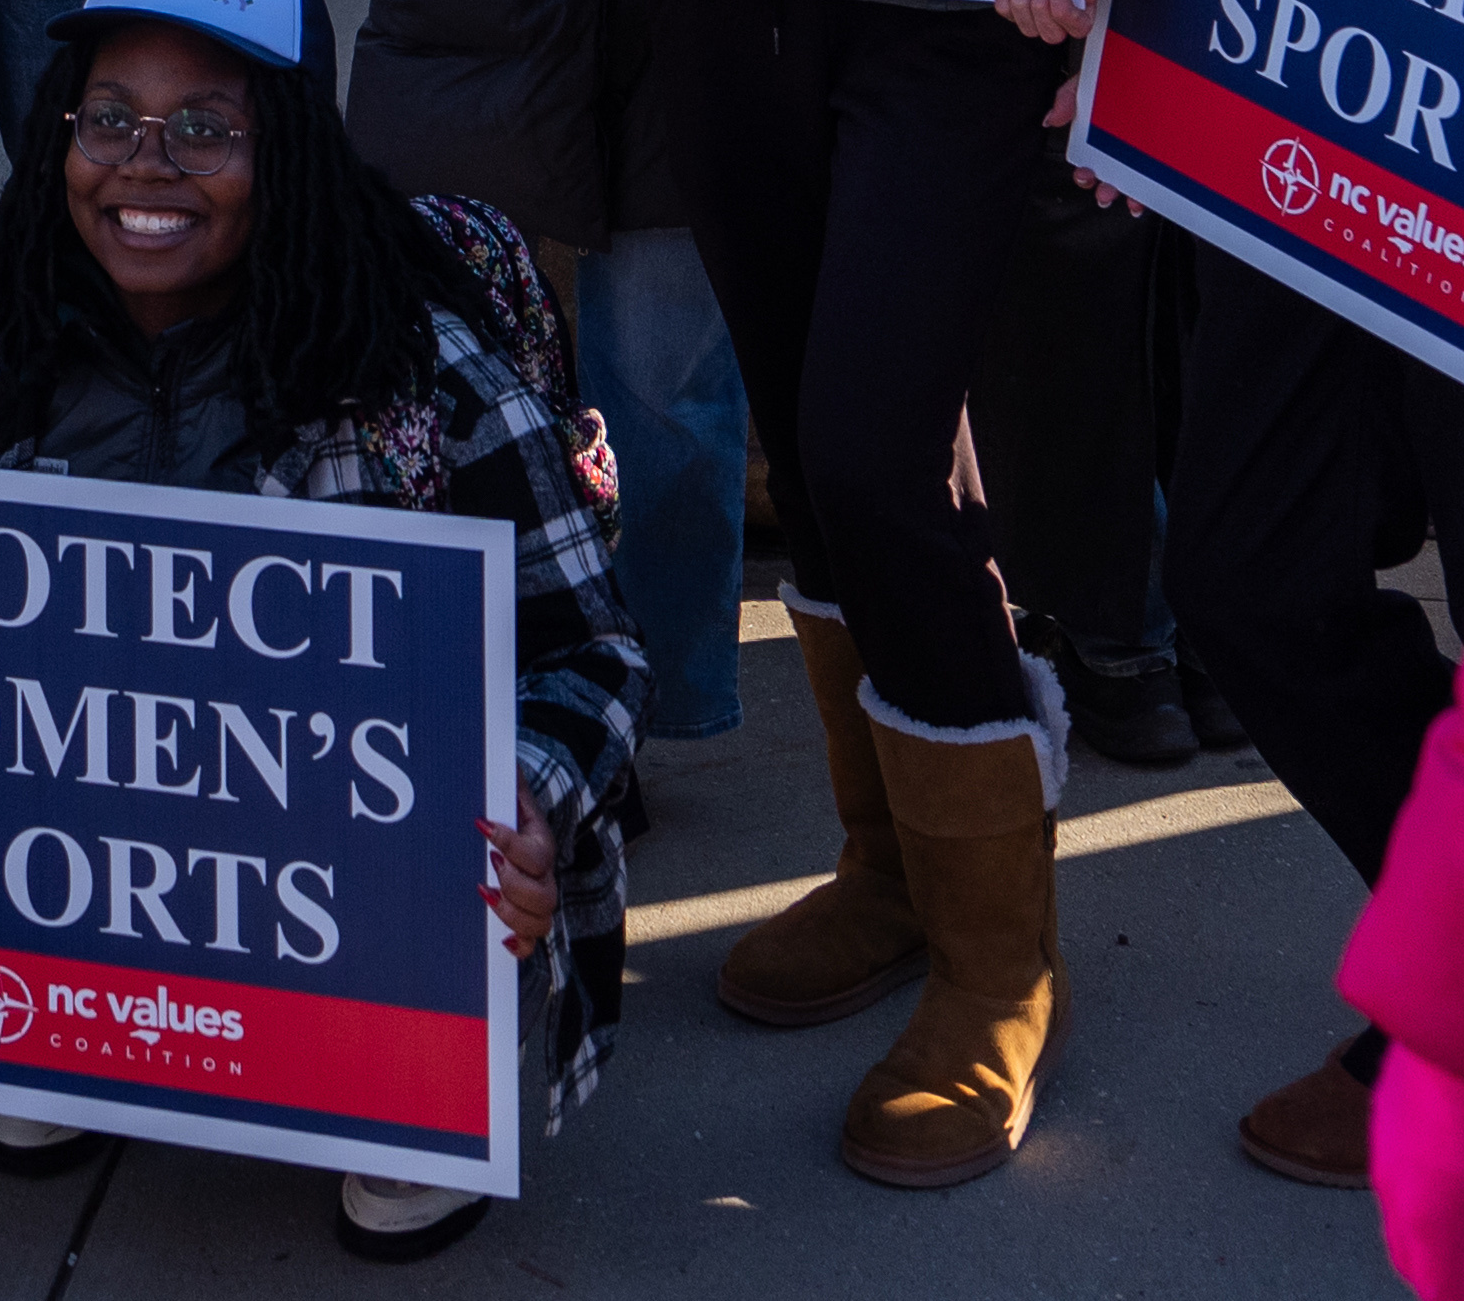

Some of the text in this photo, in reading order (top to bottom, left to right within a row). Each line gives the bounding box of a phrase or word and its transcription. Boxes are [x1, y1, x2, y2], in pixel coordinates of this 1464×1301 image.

[1330, 172, 1368, 216] nc
[47, 983, 245, 1042] nc values
[50, 1033, 244, 1076] COALITION
